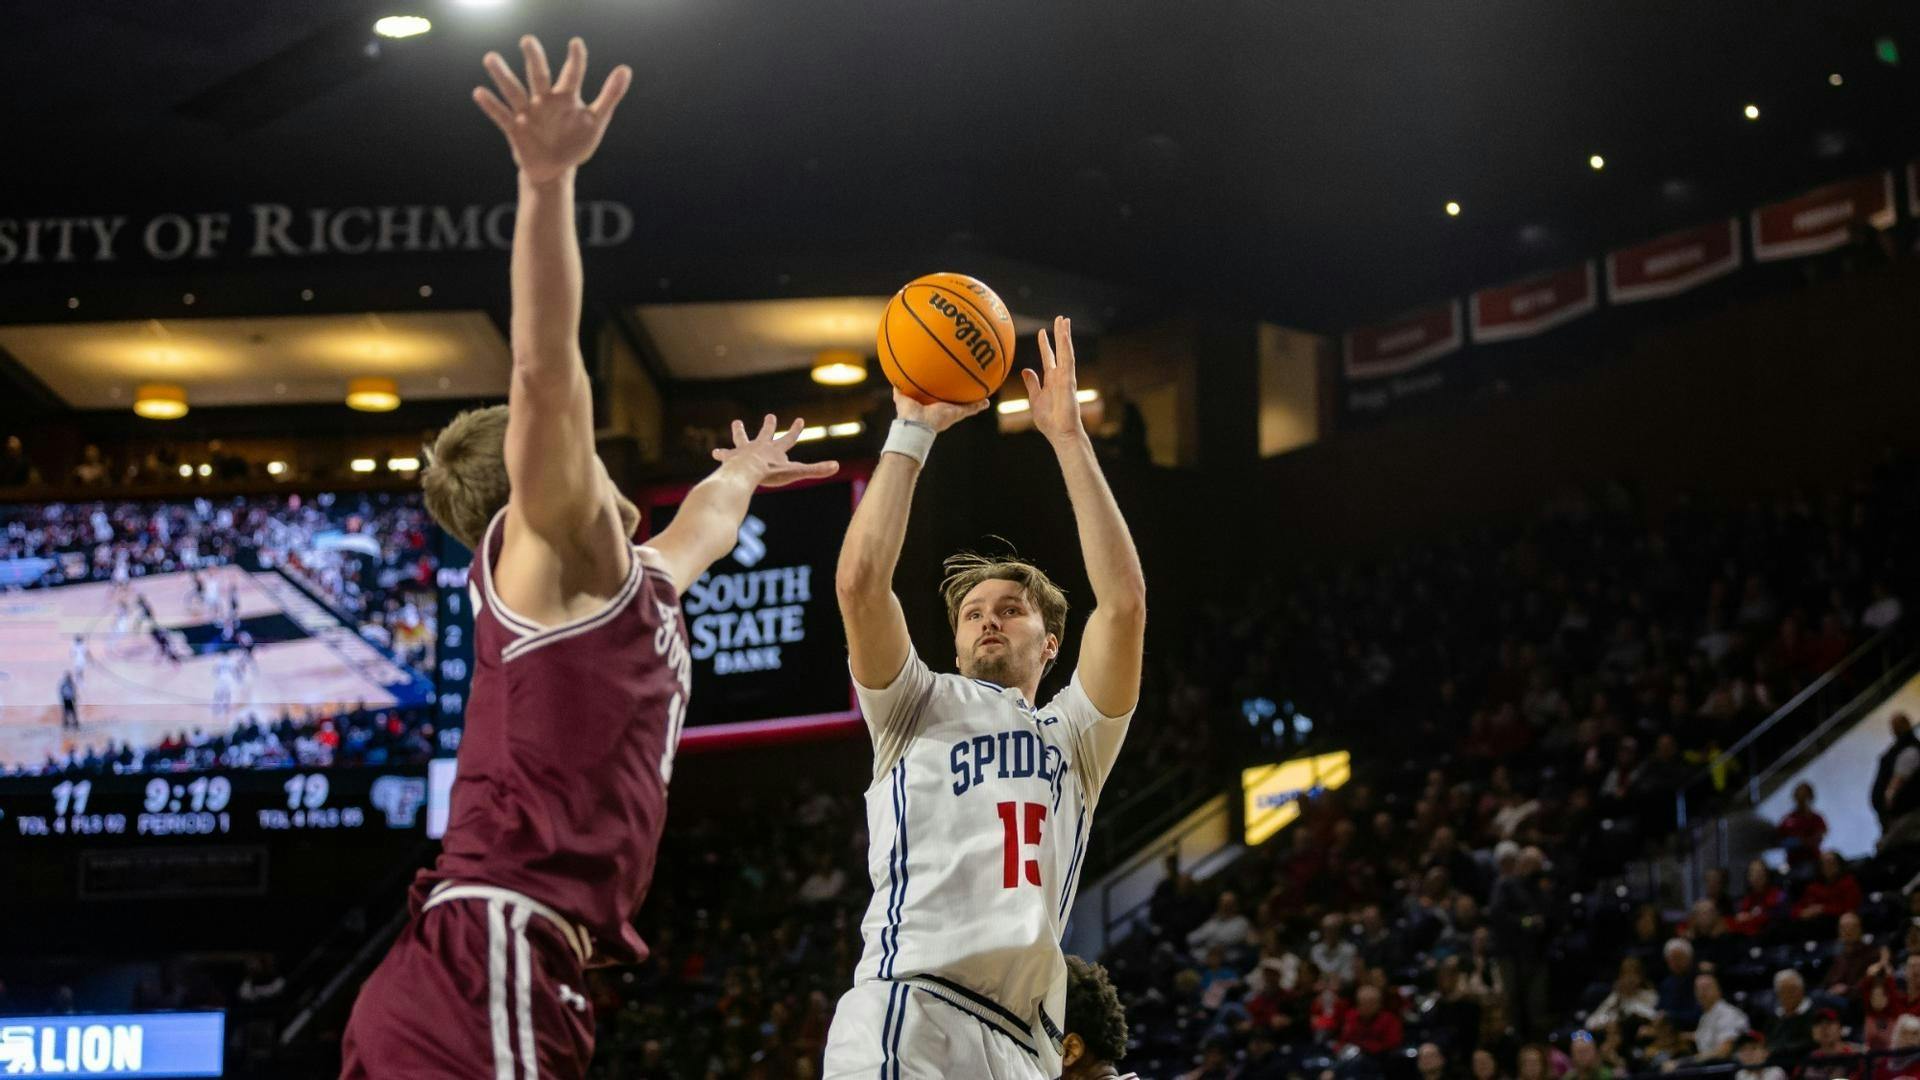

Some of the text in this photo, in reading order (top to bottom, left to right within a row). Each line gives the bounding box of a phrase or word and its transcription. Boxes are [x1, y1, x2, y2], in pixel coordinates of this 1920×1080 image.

[144, 211, 232, 261] OF
[249, 198, 634, 258] RICHMOD
[929, 292, 996, 371] Wilson
[685, 565, 811, 615] SOUTH
[691, 604, 805, 660] STATE
[714, 645, 782, 675] BANK
[51, 780, 92, 816] 11
[144, 775, 232, 813] 9:19
[284, 773, 330, 810] 19
[137, 812, 215, 835] PERIOD
[997, 801, 1047, 888] 15
[41, 1025, 143, 1073] LION
